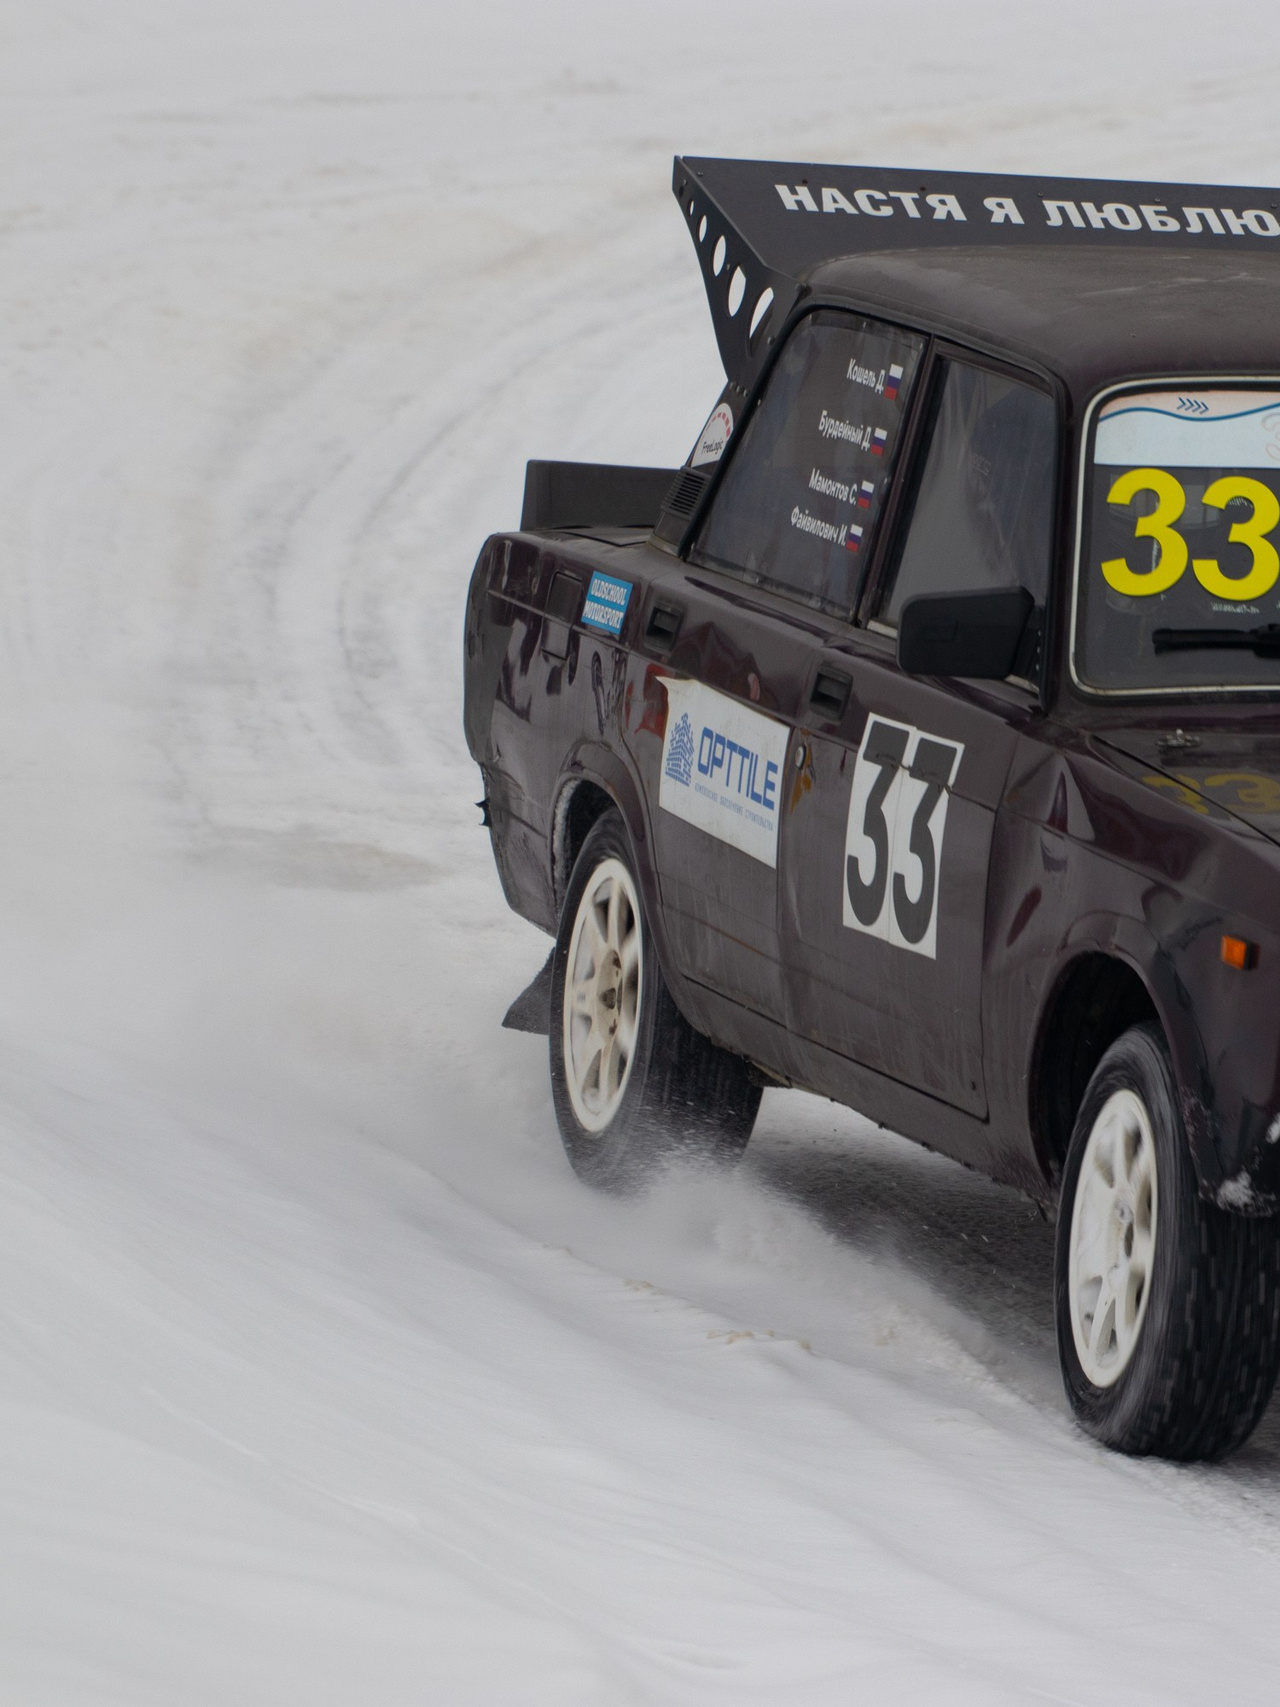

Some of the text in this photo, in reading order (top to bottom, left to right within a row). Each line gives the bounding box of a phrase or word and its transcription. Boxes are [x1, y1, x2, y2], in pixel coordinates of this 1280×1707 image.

[774, 184, 967, 222] НАСТЯ
[983, 197, 1025, 225] Я
[847, 358, 876, 388] Кошель
[819, 410, 864, 445] Бурдейный
[808, 467, 849, 501] Мамонтов
[791, 506, 840, 542] Файвилович
[1101, 468, 1280, 600] 33
[591, 578, 627, 606] OLDSCHOOL
[582, 600, 624, 629] MOTORSPORT
[698, 726, 779, 811] OPTTILE
[847, 720, 958, 944] 33
